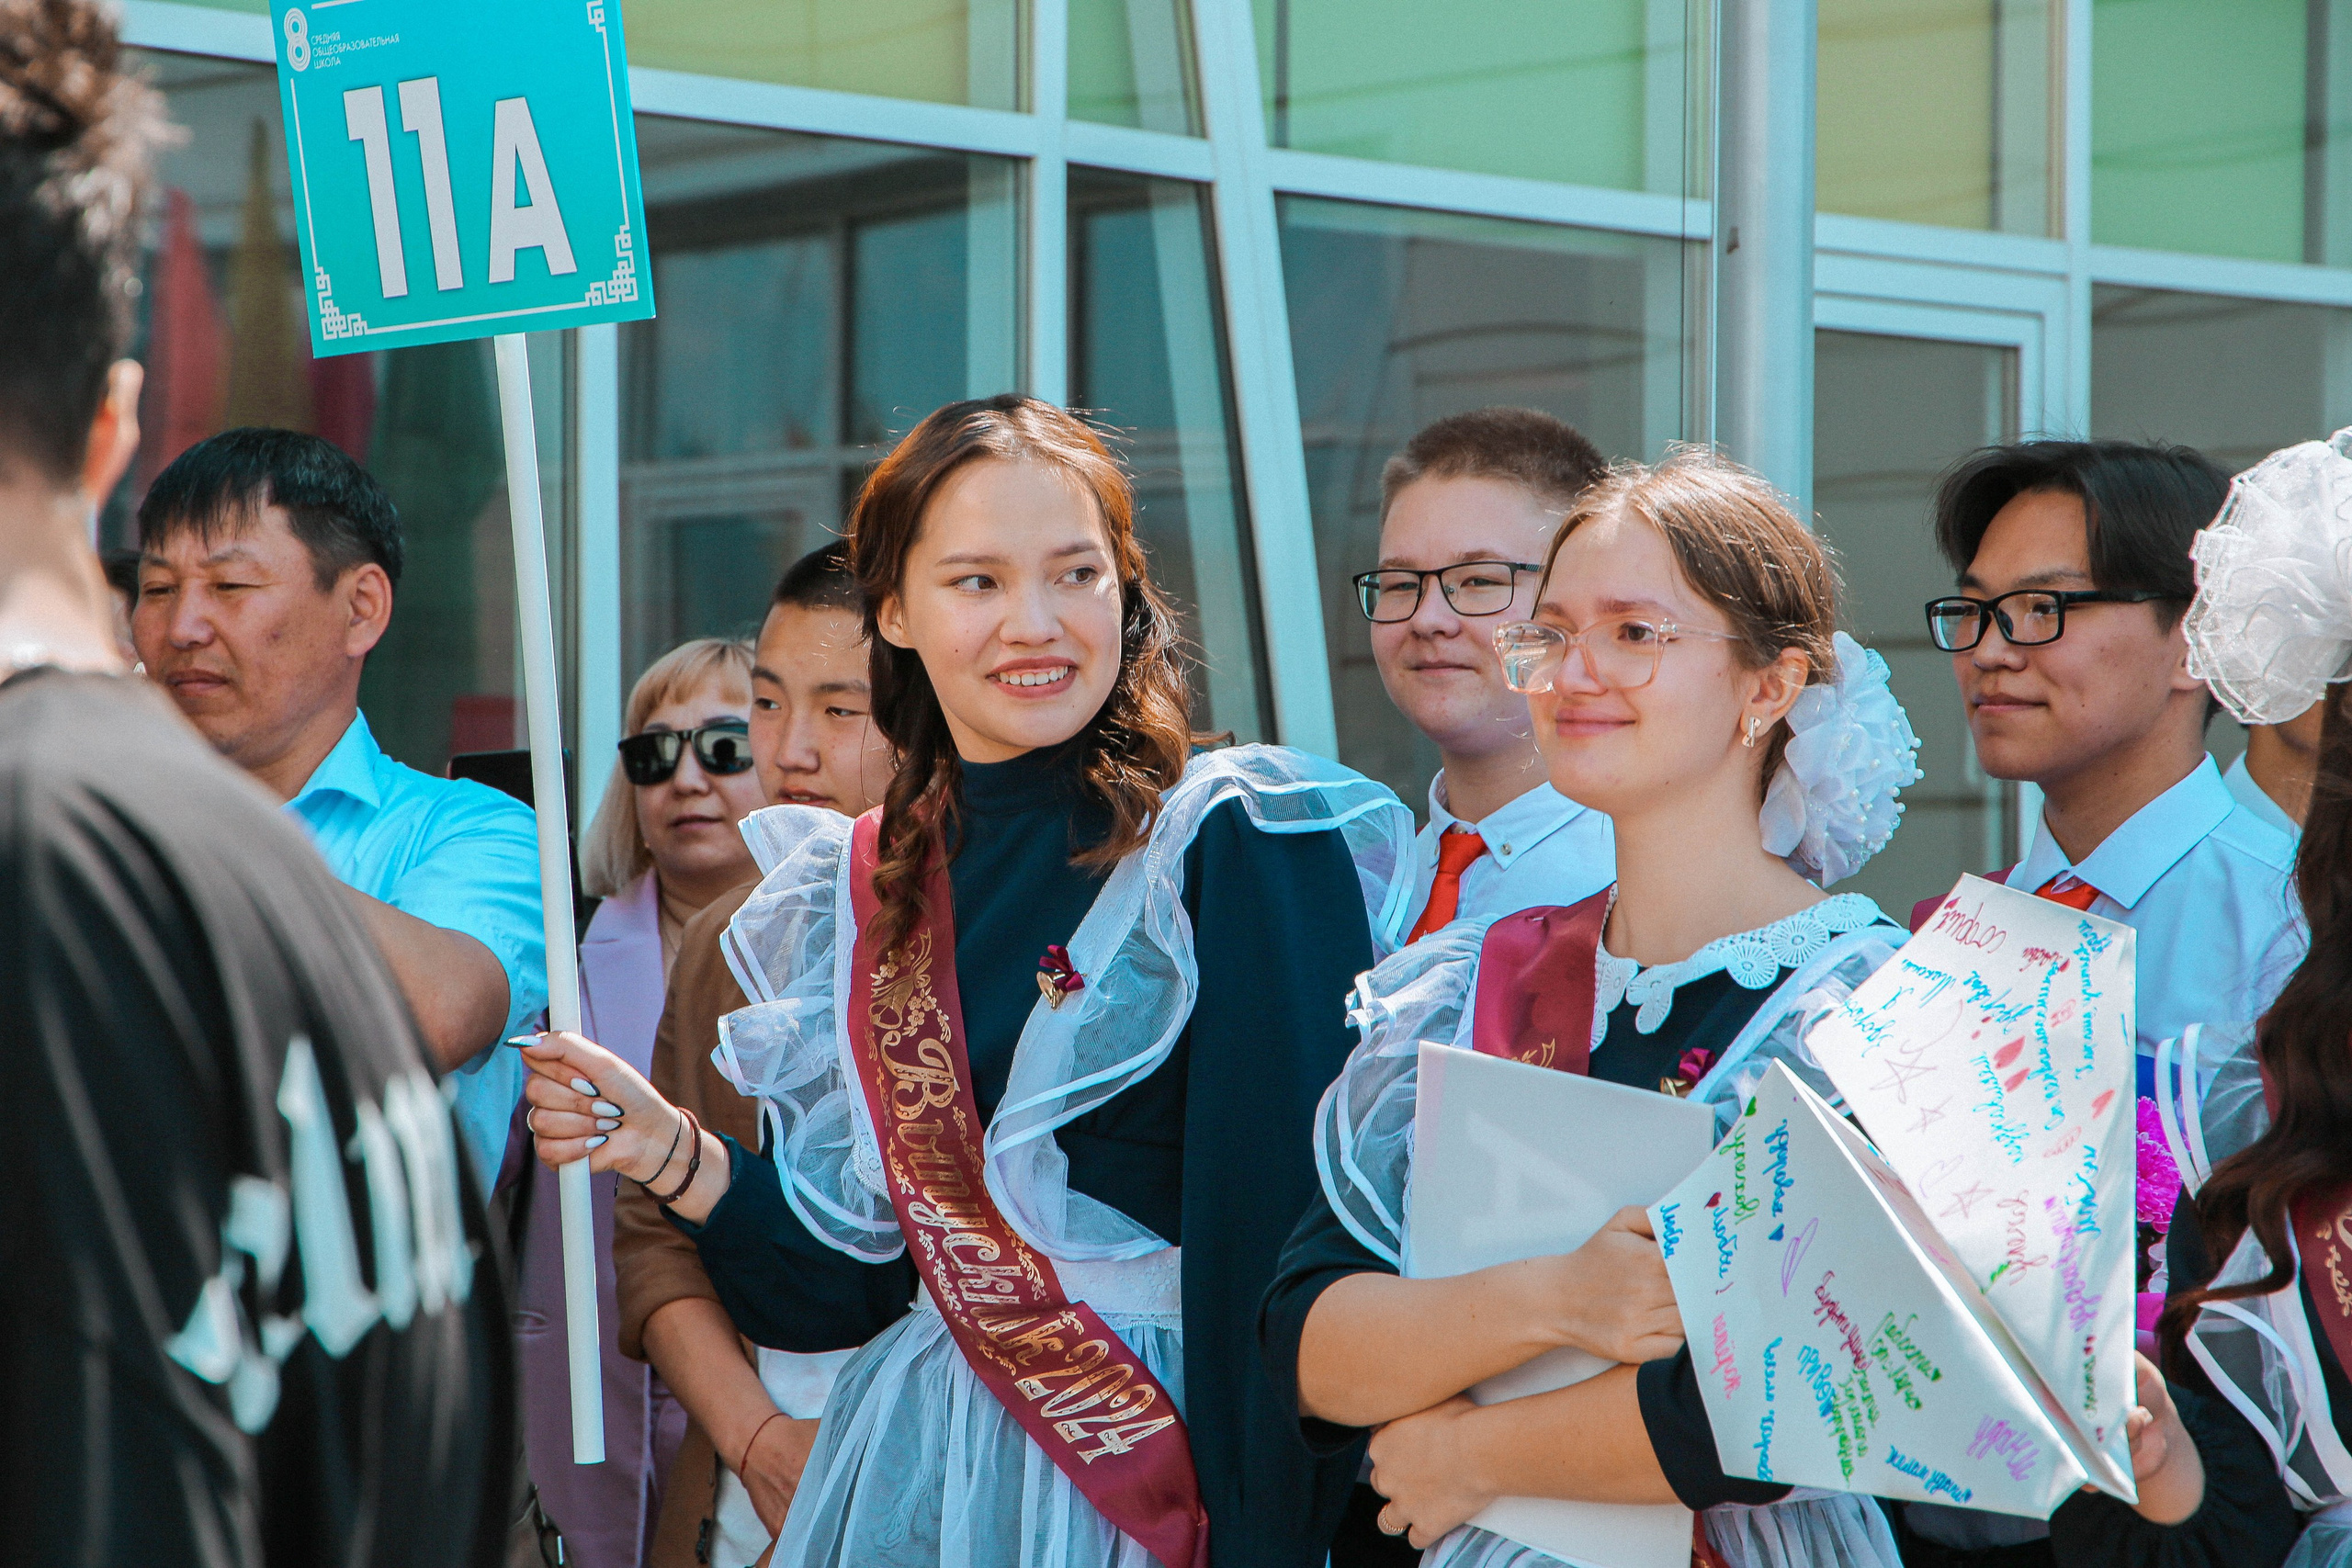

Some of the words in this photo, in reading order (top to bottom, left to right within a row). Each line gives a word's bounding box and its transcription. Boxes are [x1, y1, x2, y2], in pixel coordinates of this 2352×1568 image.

[311, 31, 341, 45] СРЕДНЯЯ
[312, 33, 401, 57] ОБЩЕОБРАЗОВАТЕЛЬНАЯ
[313, 56, 342, 70] ШКОЛА
[1014, 1338, 1177, 1465] 2024
